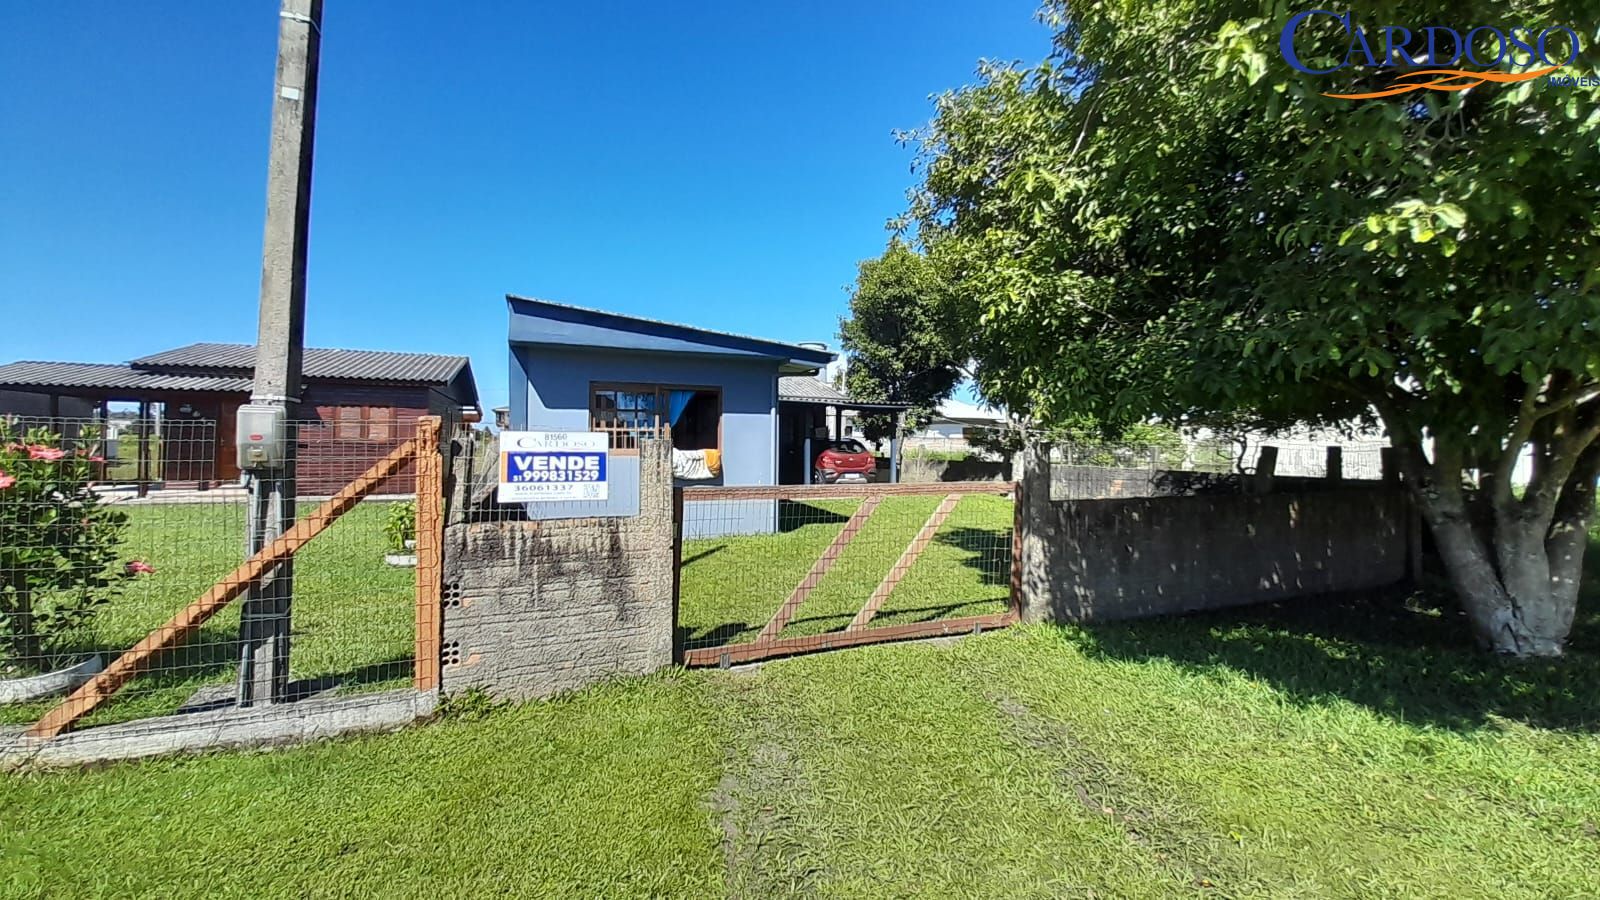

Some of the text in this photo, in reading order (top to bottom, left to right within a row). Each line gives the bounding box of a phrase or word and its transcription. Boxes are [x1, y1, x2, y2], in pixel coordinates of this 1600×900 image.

[513, 456, 600, 470] VENDE
[523, 470, 599, 482] 999831529
[514, 484, 574, 492] 36061337
